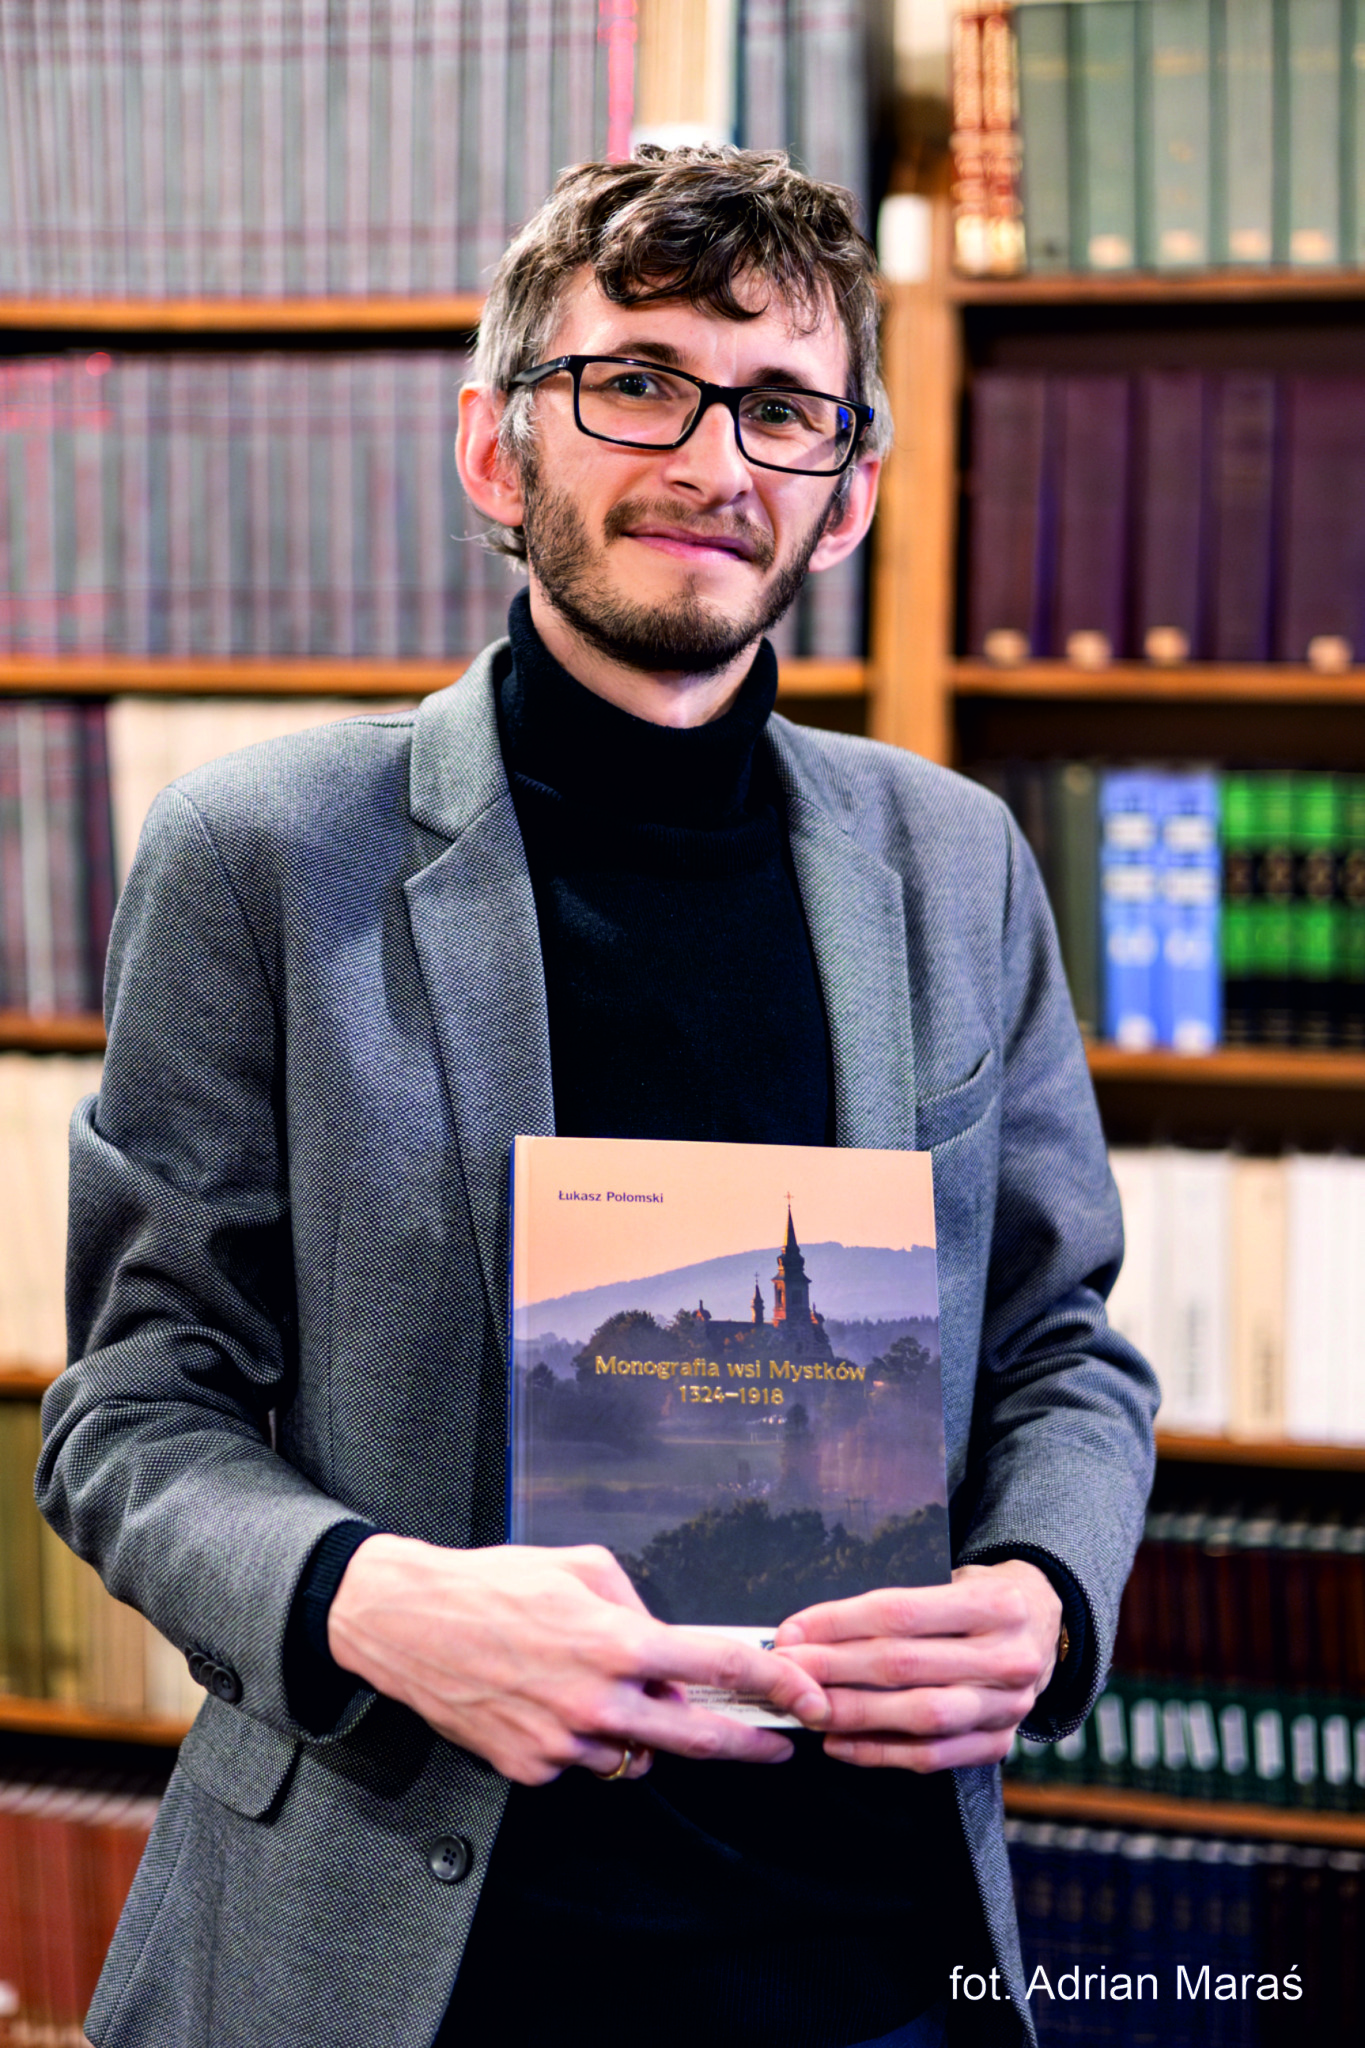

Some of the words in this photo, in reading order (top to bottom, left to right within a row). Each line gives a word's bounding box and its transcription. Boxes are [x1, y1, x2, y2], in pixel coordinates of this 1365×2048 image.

[558, 1190, 602, 1202] Łukasz
[595, 1355, 720, 1380] Monografia
[726, 1360, 761, 1379] wsi
[769, 1360, 867, 1383] Mystków
